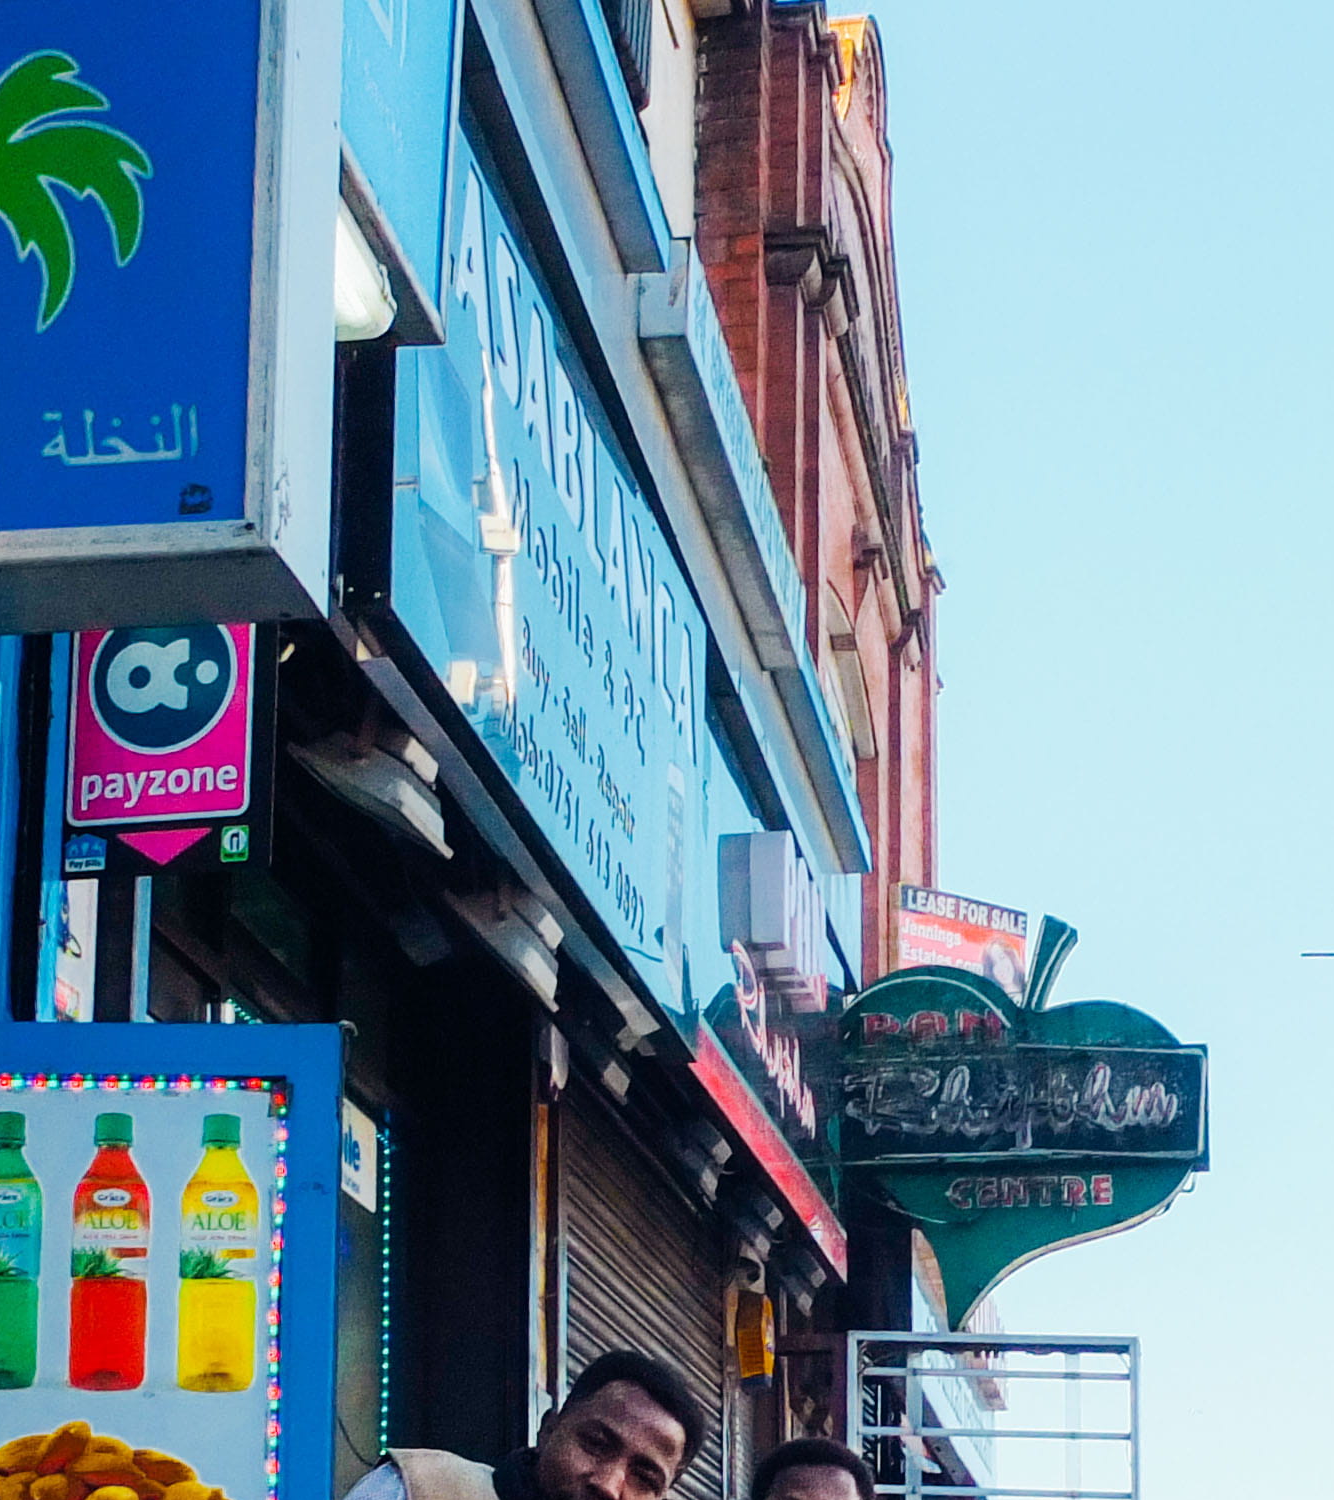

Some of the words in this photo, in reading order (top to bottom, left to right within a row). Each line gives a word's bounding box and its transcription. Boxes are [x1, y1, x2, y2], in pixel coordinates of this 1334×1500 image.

[41, 404, 199, 468] النخلة
[451, 160, 696, 767] ASABLANCA
[80, 765, 238, 811] payzone
[907, 889, 957, 919] LEASE
[958, 900, 989, 928] FOR
[991, 909, 1027, 936] SALE
[946, 1174, 1115, 1210] CENTRE
[84, 1211, 139, 1230] ALOE
[192, 1211, 247, 1231] ALOE
